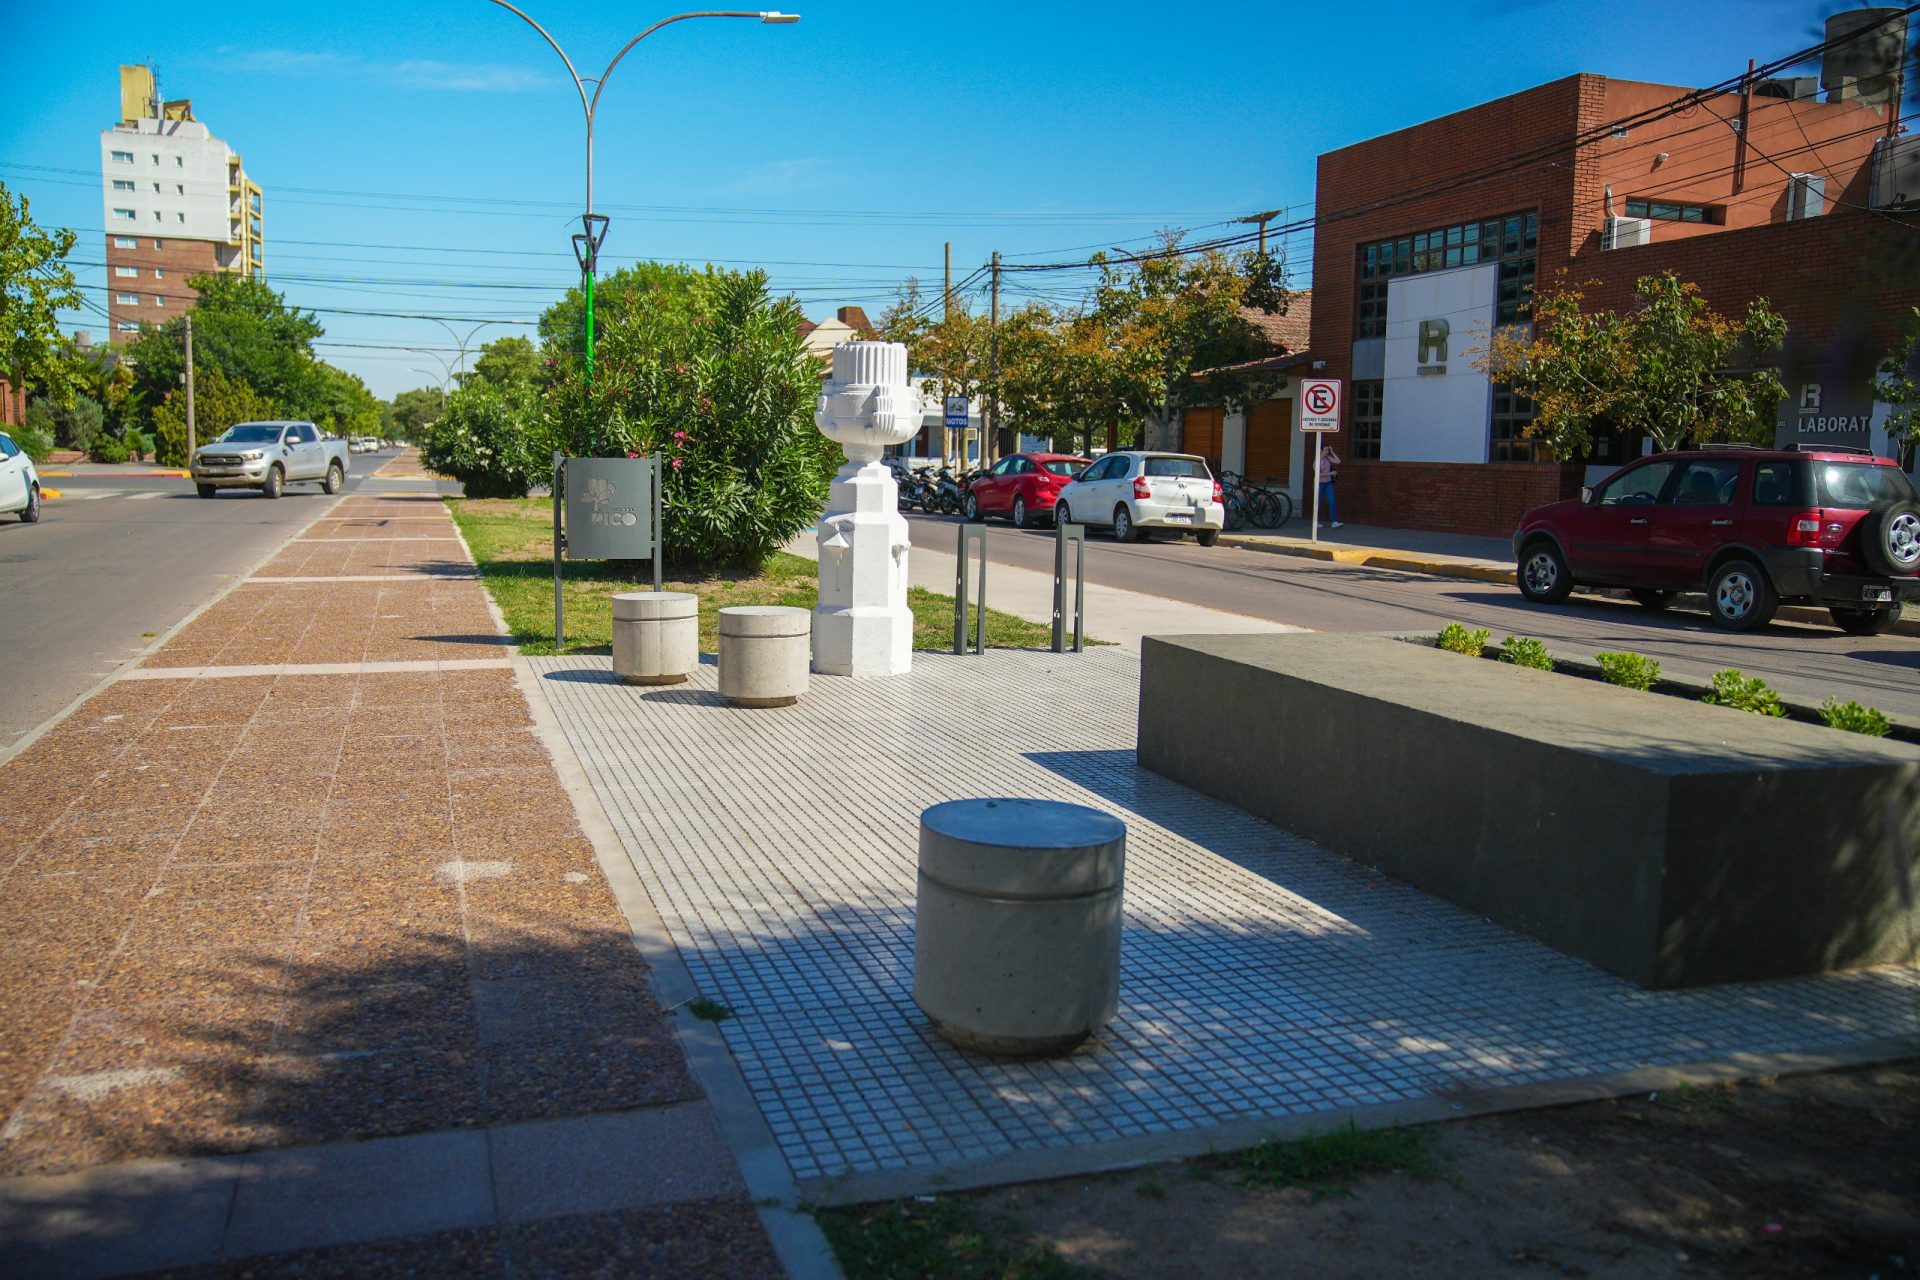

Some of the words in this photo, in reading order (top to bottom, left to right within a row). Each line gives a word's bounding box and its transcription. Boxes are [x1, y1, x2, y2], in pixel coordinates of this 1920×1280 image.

[1313, 389, 1328, 409] E
[946, 417, 968, 425] MOTOS
[1798, 416, 1872, 432] LABORAT
[591, 512, 637, 526] PICO
